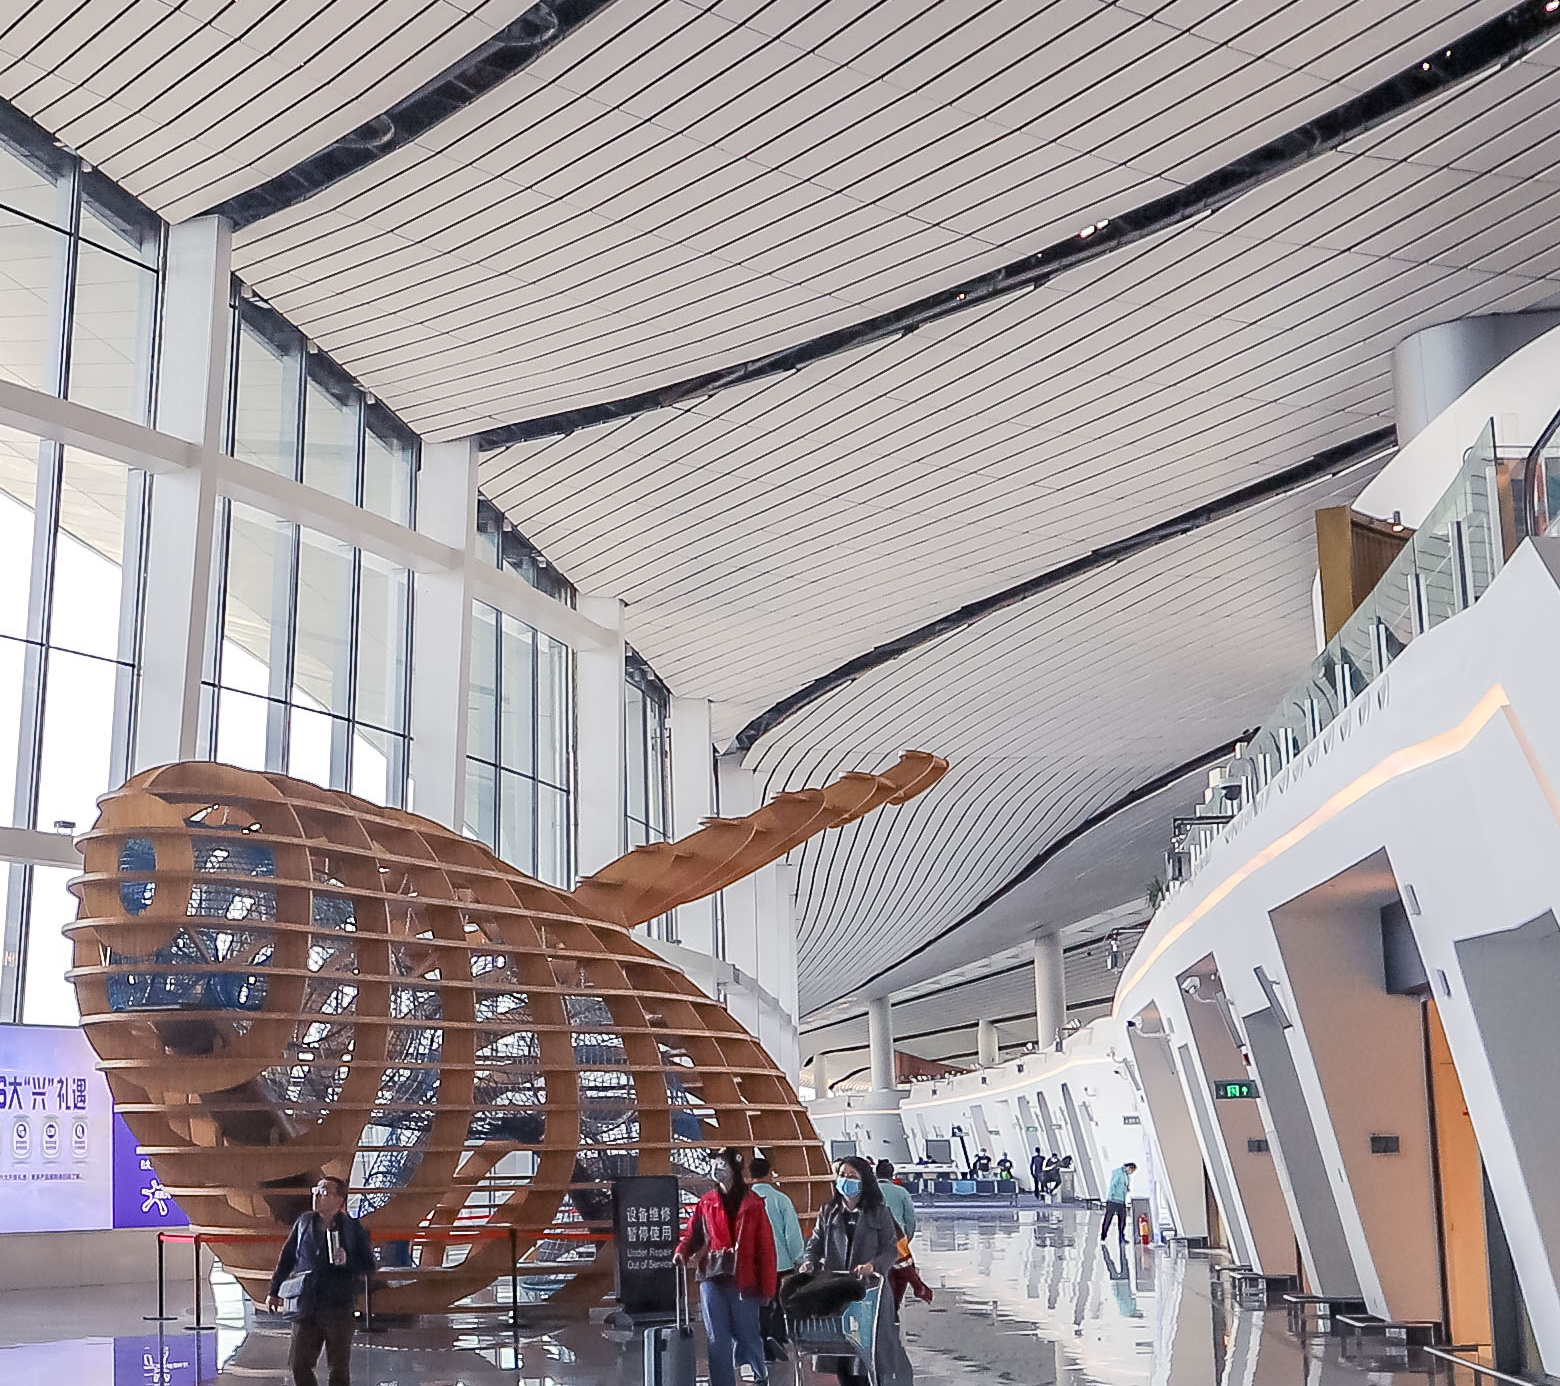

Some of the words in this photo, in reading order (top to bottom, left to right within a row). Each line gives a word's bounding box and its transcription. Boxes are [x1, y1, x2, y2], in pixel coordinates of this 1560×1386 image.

[626, 1206, 671, 1222] 设备维修
[627, 1225, 672, 1242] 暂停使用
[627, 1248, 647, 1258] Under
[649, 1247, 672, 1258] Repair
[627, 1260, 640, 1270] Out
[640, 1260, 648, 1270] of
[648, 1260, 673, 1270] Service
